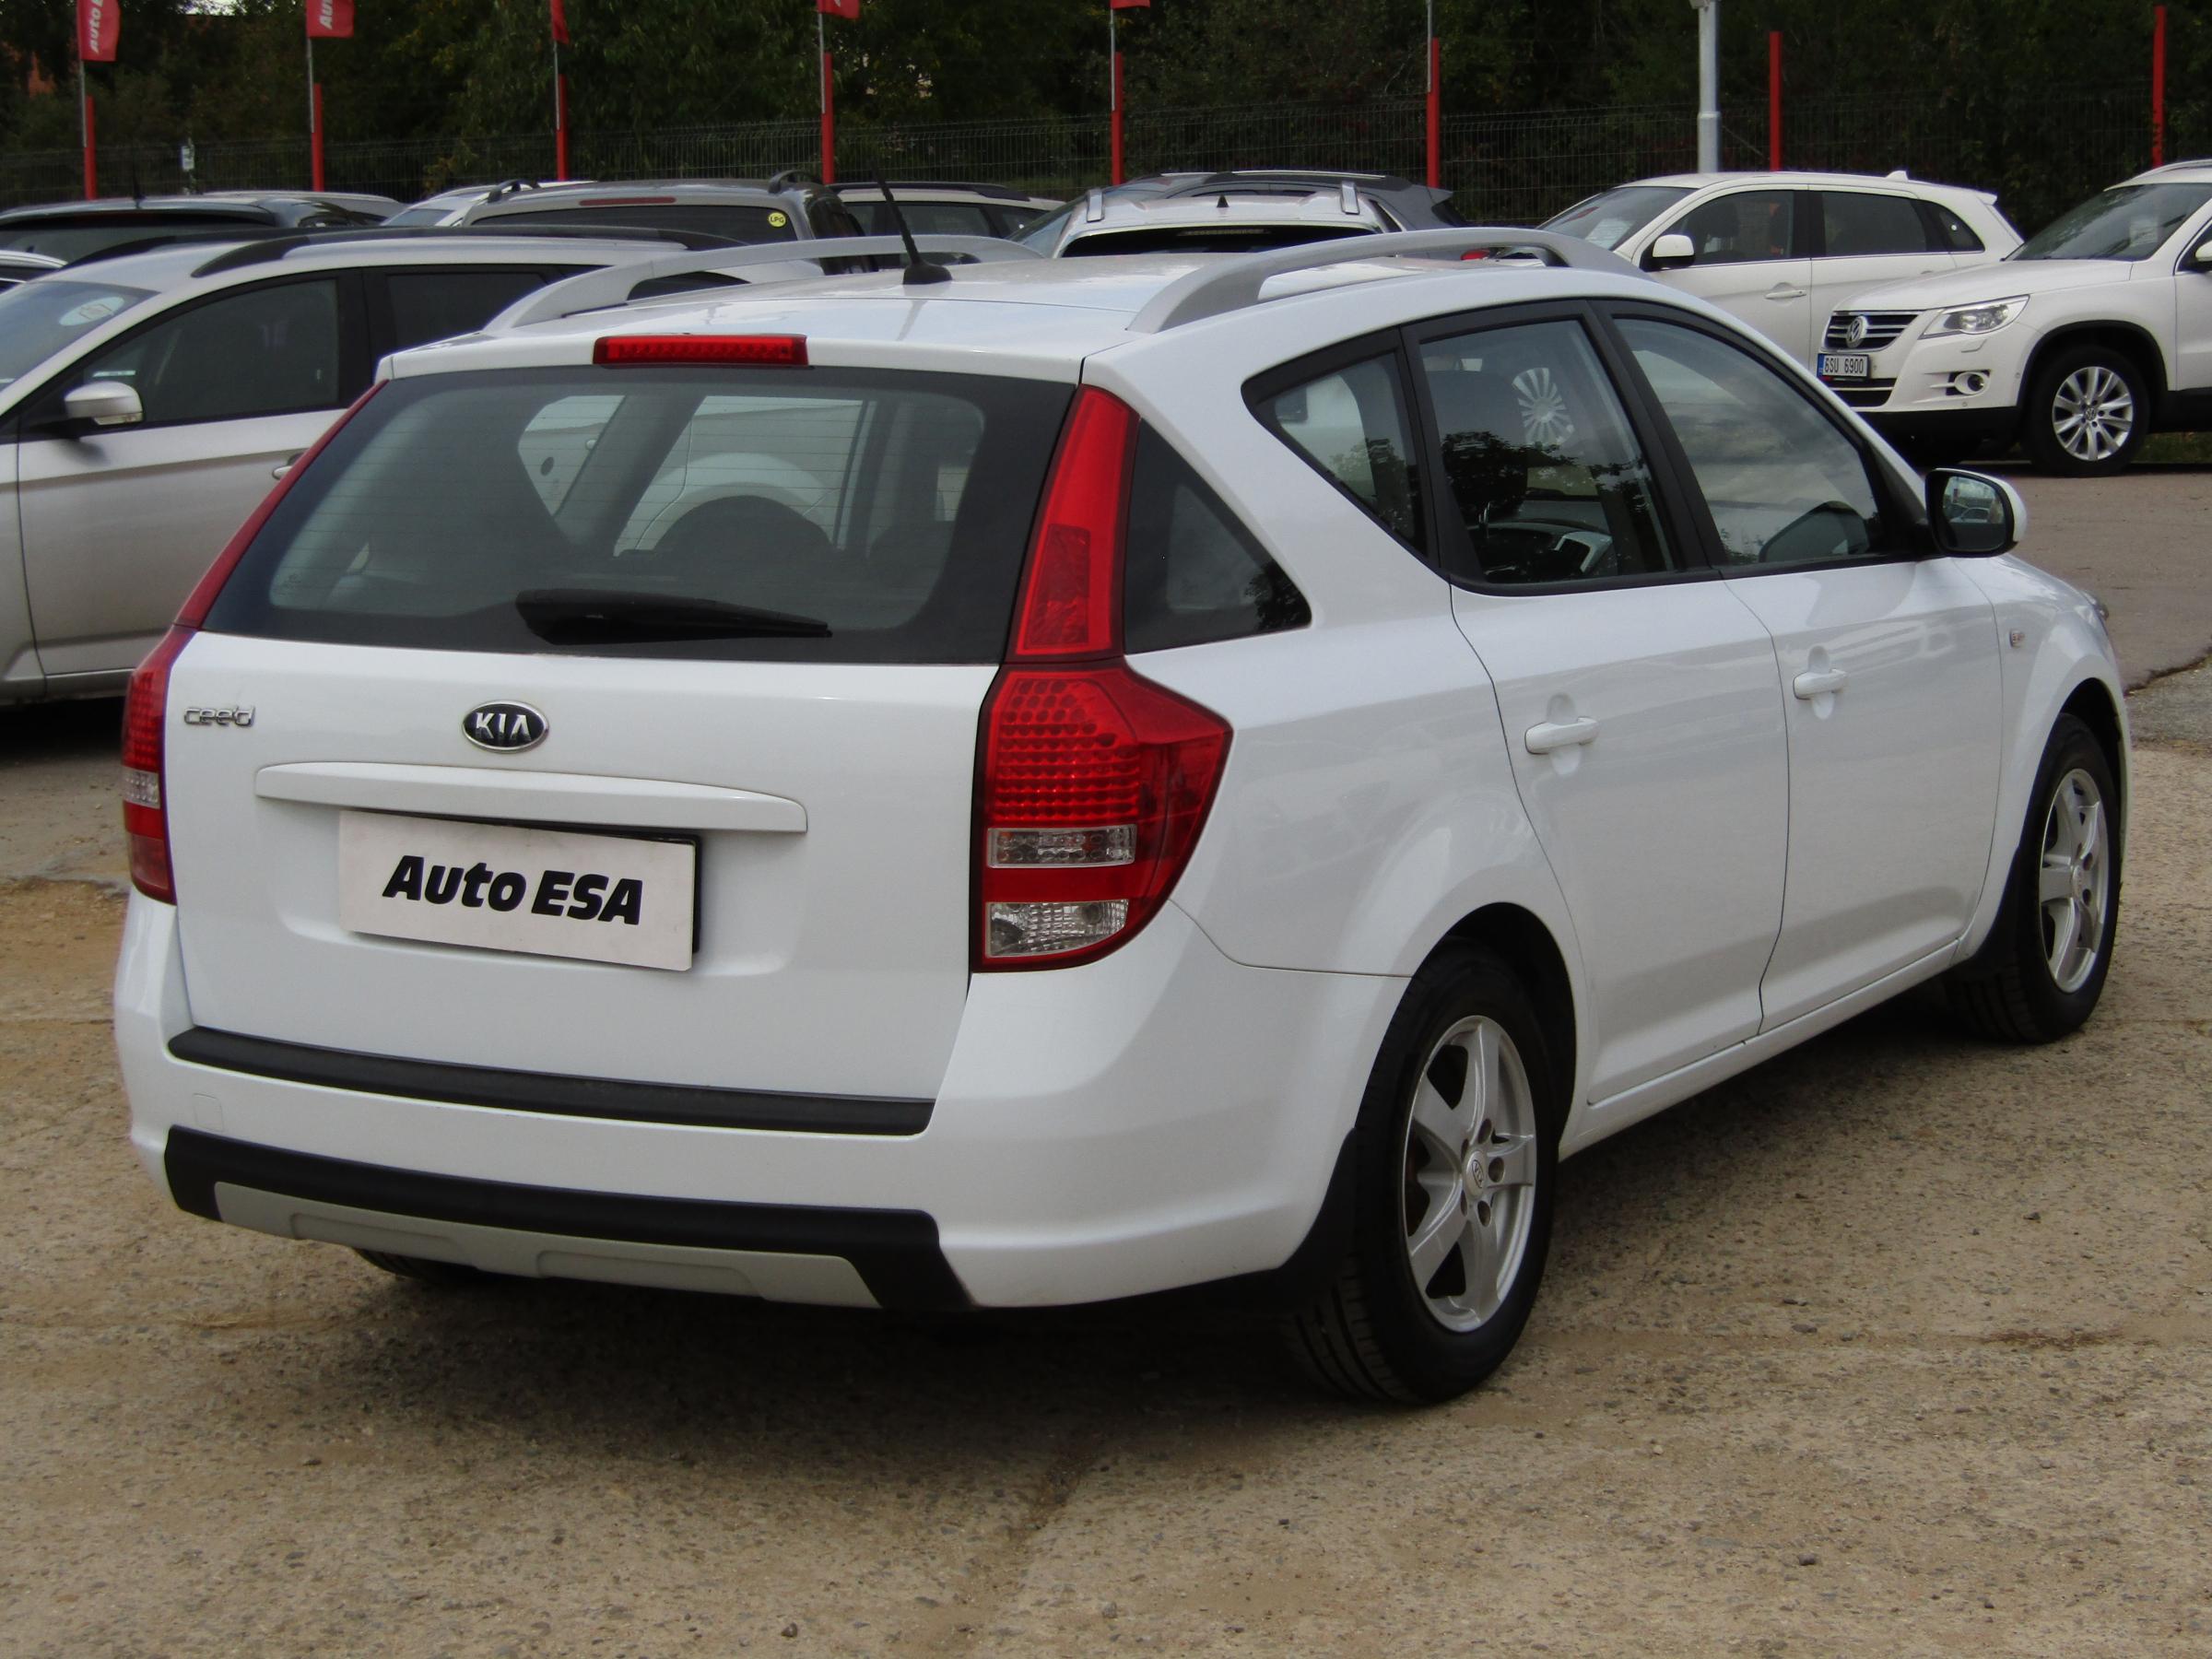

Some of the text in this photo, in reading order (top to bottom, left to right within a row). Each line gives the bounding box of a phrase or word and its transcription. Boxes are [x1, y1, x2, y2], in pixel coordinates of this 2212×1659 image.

[88, 7, 102, 54] Auto
[1844, 359, 1864, 373] 6900
[476, 712, 532, 741] KIA
[382, 854, 643, 925] Auto ESA
